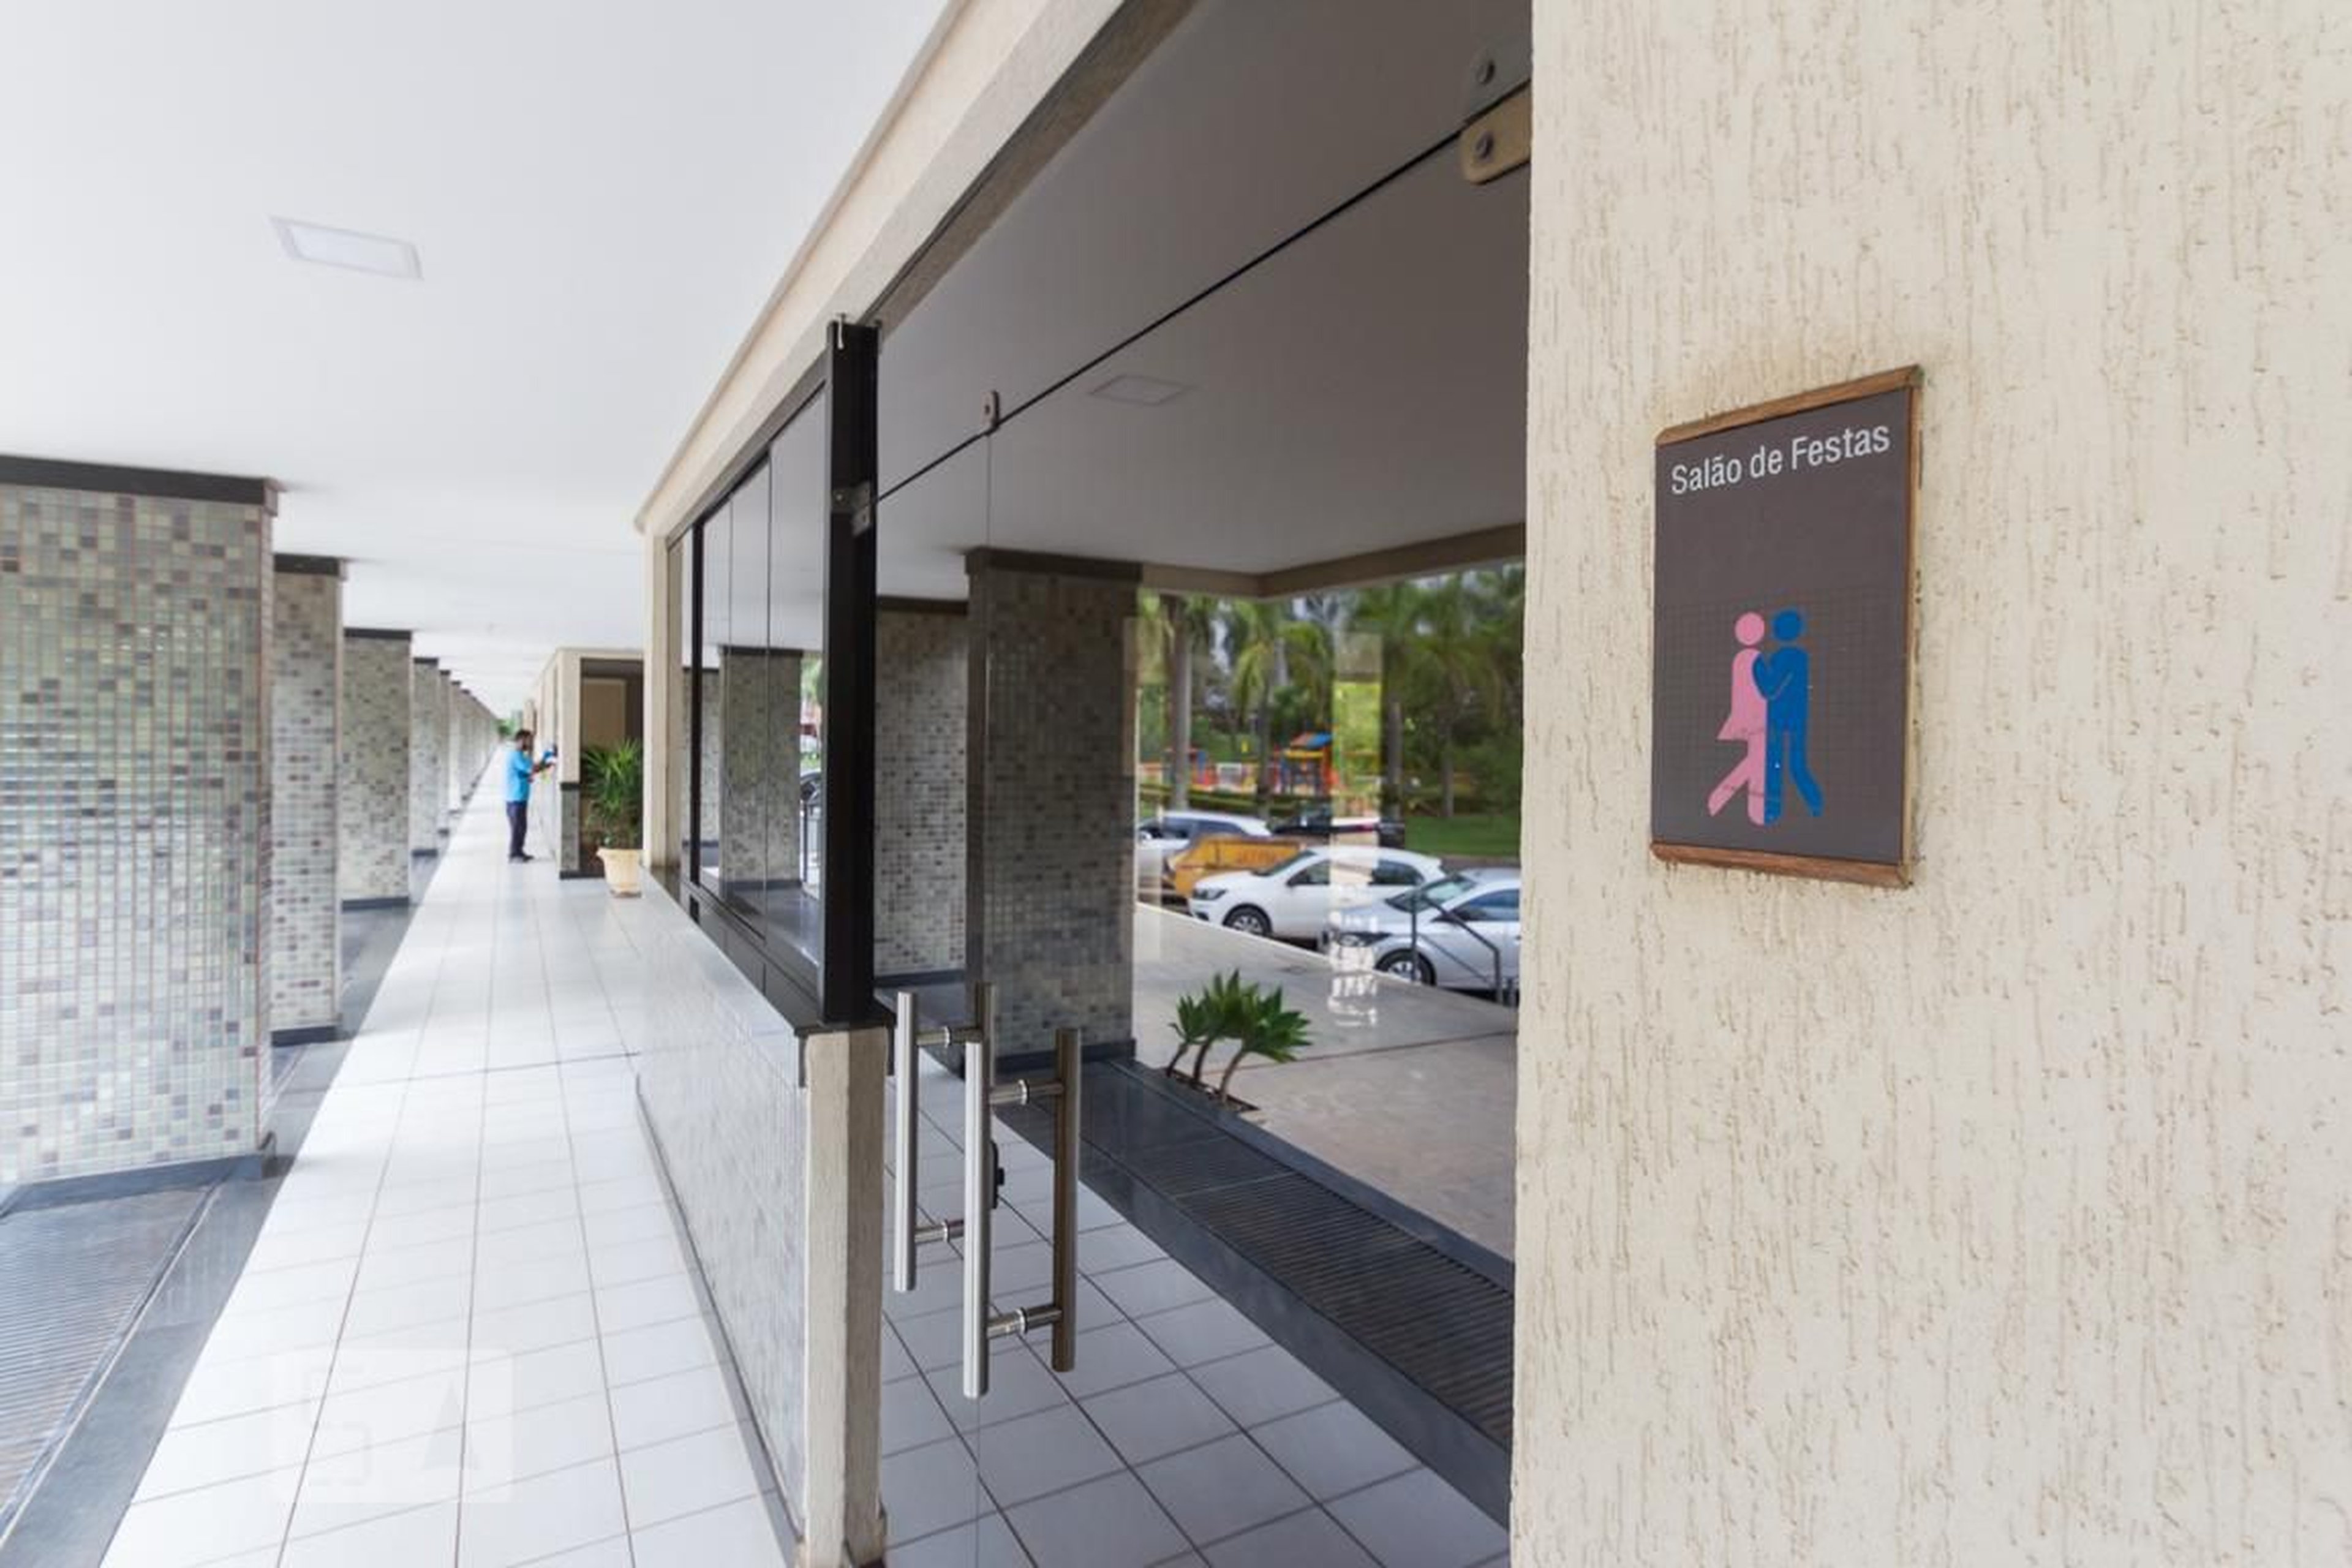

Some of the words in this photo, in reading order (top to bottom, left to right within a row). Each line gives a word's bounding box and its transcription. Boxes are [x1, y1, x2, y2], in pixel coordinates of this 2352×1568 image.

[1672, 454, 1742, 495] Salão
[1750, 445, 1782, 478] de
[1792, 426, 1891, 470] Festas
